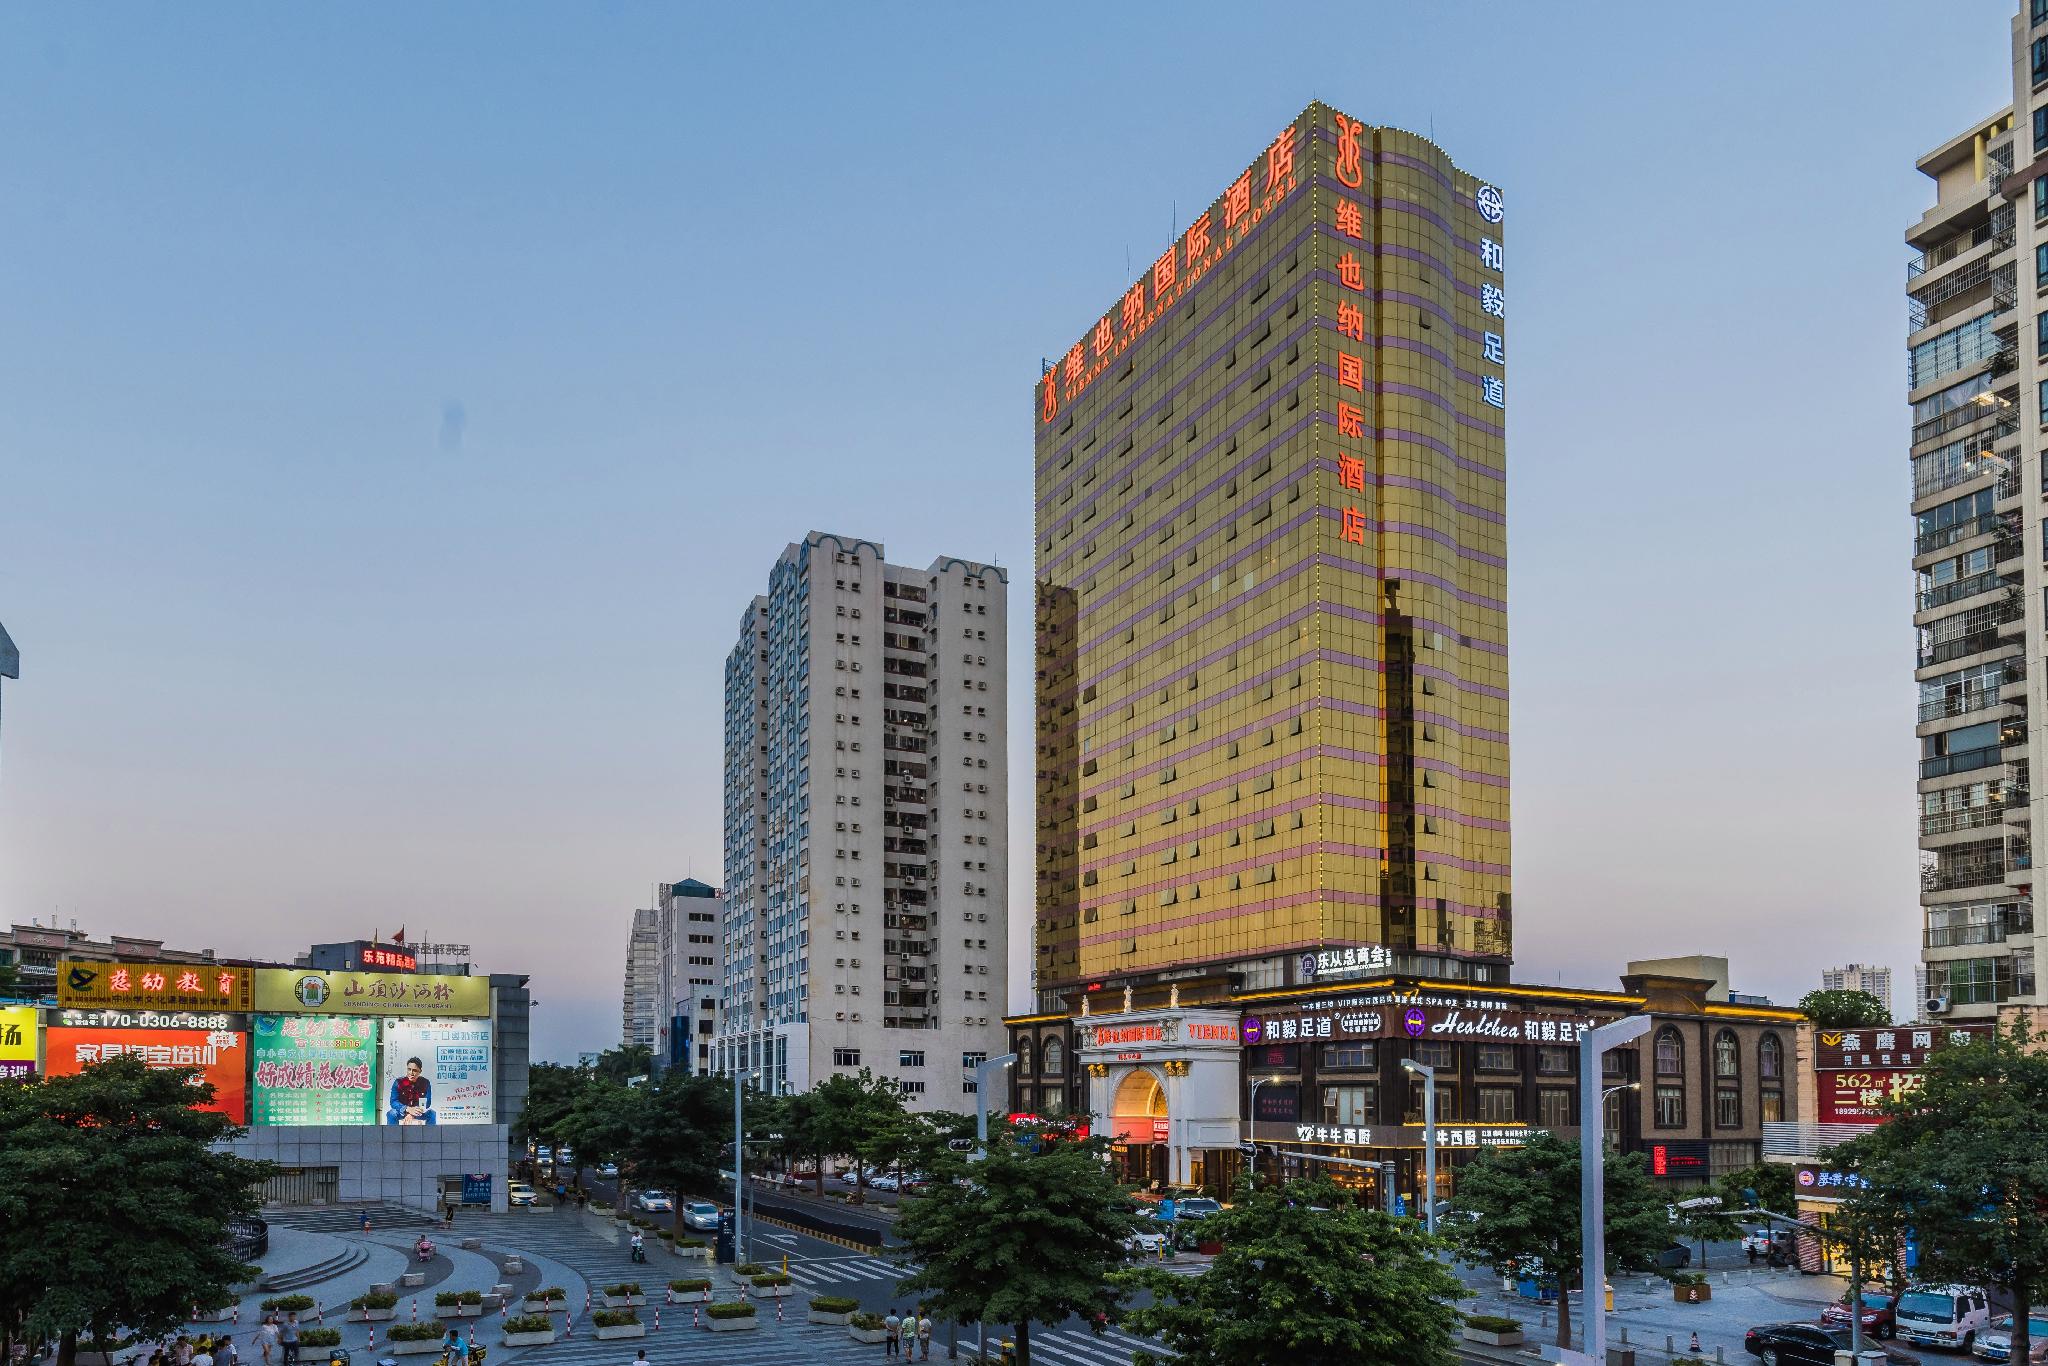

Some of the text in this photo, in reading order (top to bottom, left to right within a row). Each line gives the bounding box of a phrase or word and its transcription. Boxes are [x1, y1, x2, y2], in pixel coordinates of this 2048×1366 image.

[1064, 125, 1298, 387] 维也纳国际酒店
[1066, 176, 1298, 402] VIENNA INTERNATIONAL HOTEL
[1480, 237, 1506, 410] 和毅足道
[1335, 197, 1366, 546] 维也纳国际酒店
[363, 950, 416, 970] 乐苑精品酒店
[1317, 945, 1385, 970] 乐从总商会
[109, 967, 236, 995] 慈幼教育
[343, 979, 455, 1001] 山顶沙河粉
[1426, 997, 1443, 1006] SPA
[100, 1013, 228, 1030] 170-0306-8888
[281, 1016, 374, 1040] 慈幼教育
[1187, 1023, 1238, 1041] VIENNA
[1266, 1016, 1332, 1040] 和毅足道
[1431, 1010, 1520, 1039] Healthea
[75, 1043, 217, 1065] 家具淘宝培训
[255, 1060, 372, 1091] 好成绩慈幼造
[1836, 1073, 1872, 1088] 562
[1834, 1088, 1884, 1106] 二楼
[1316, 1127, 1371, 1145] 牛牛西厨
[1422, 1129, 1477, 1146] 牛西厨
